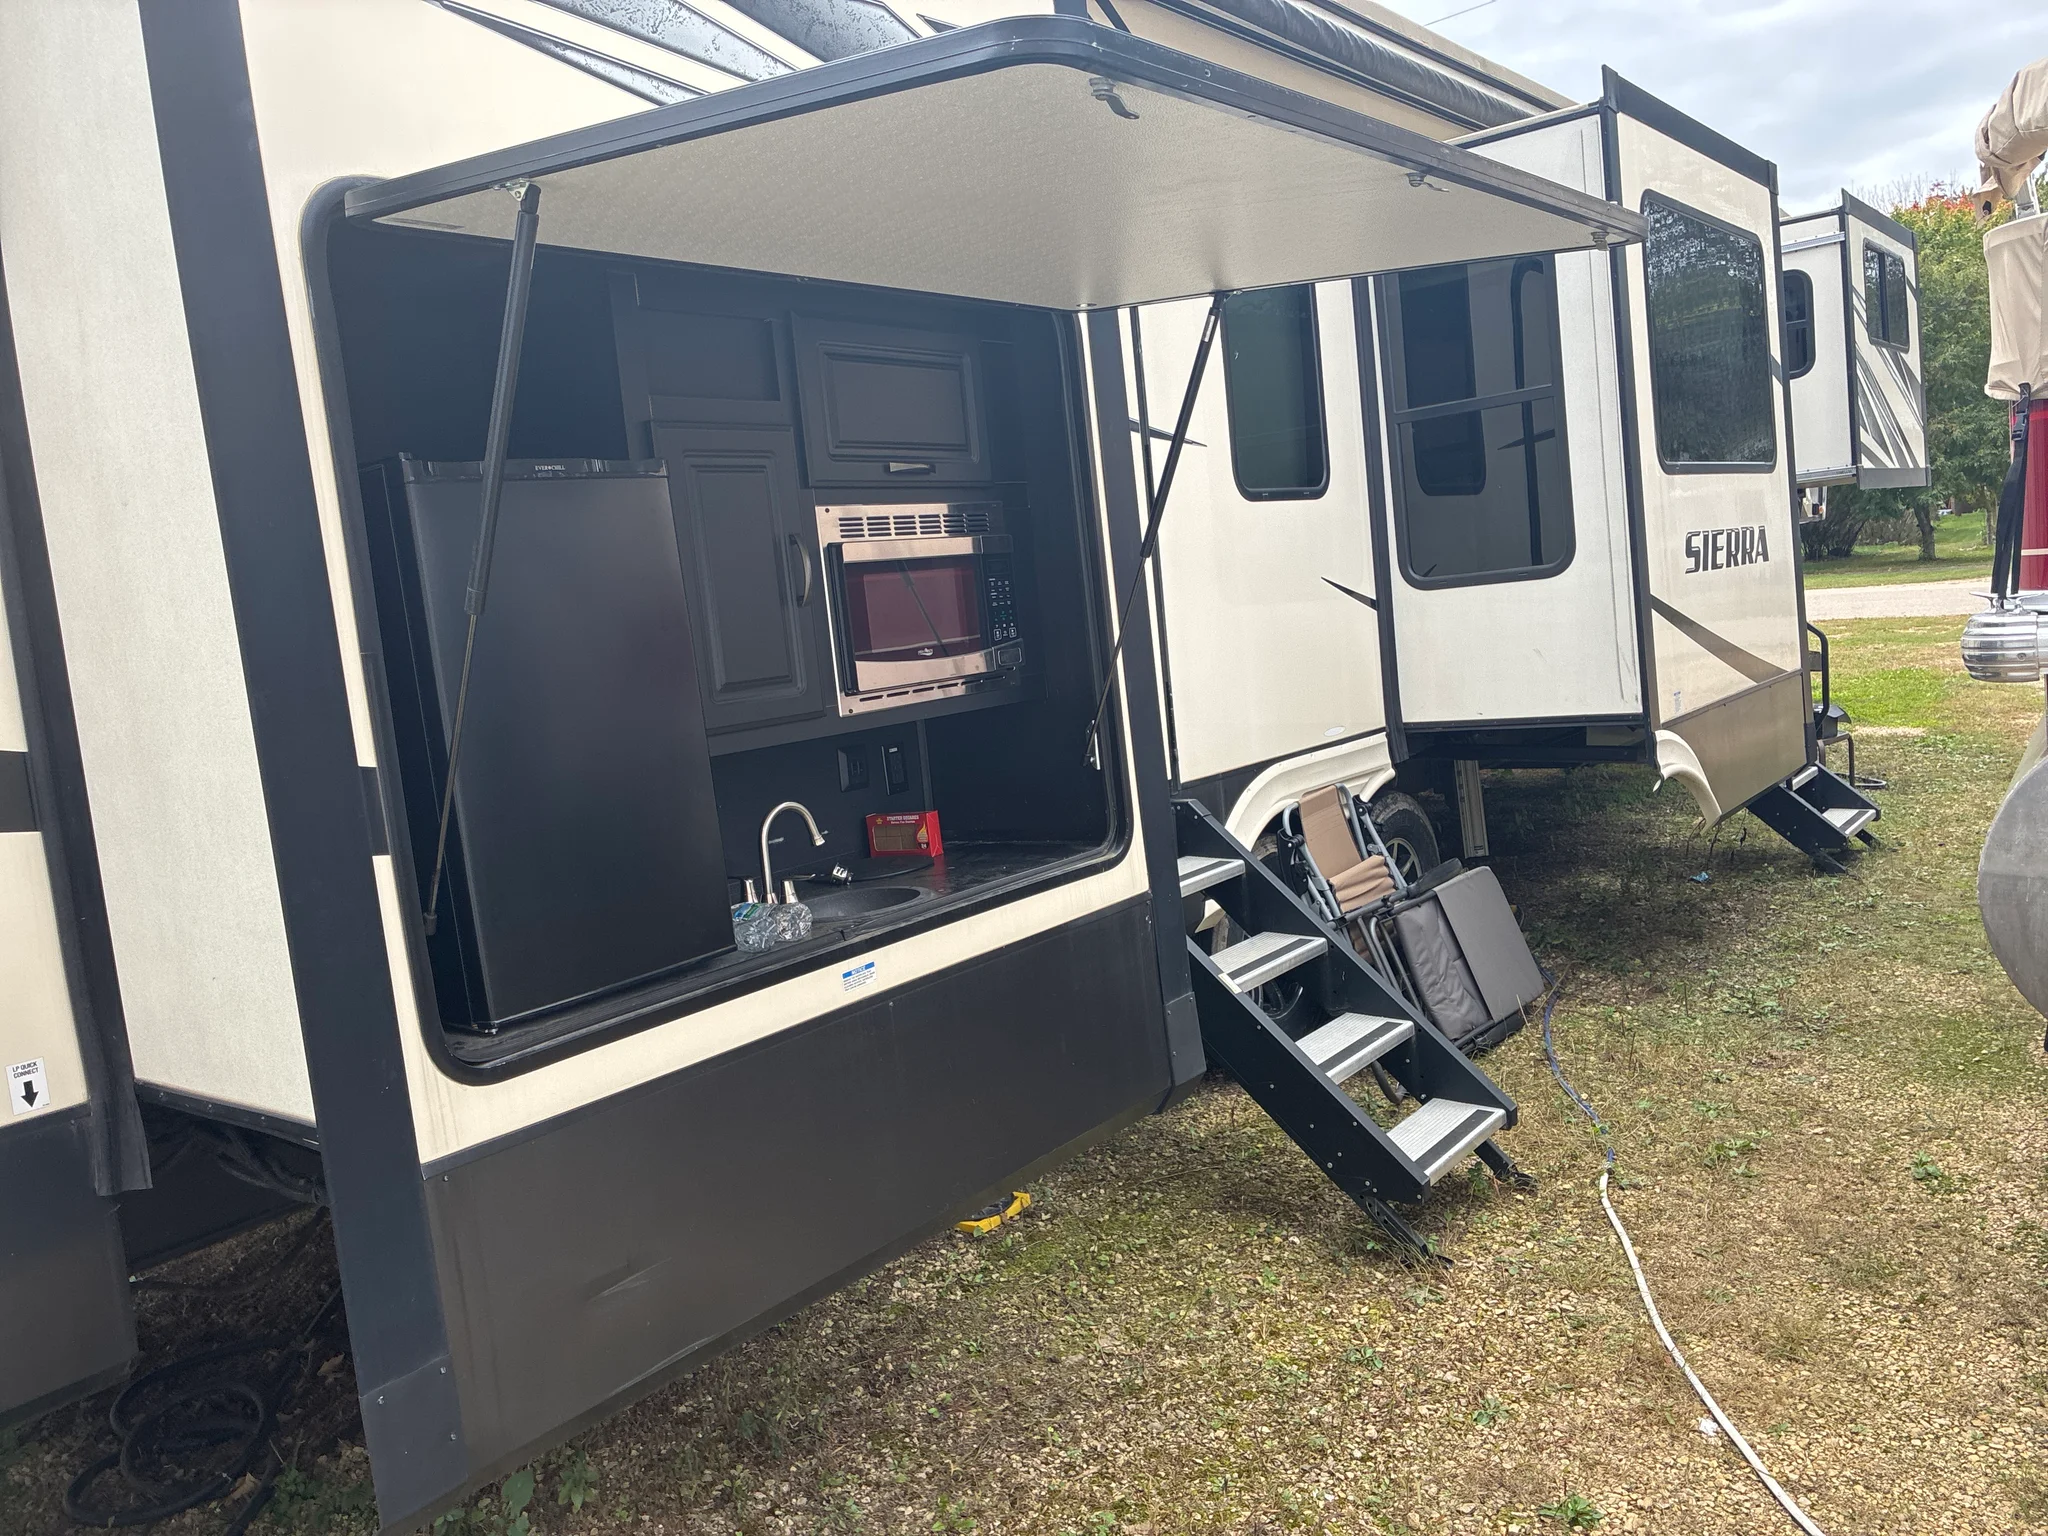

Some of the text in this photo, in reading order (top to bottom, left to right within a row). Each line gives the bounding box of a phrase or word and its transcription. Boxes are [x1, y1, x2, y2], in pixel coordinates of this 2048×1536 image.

[1685, 525, 1769, 574] SIERRA
[20, 1061, 38, 1070] QUICK
[13, 1067, 39, 1078] CONNECT
